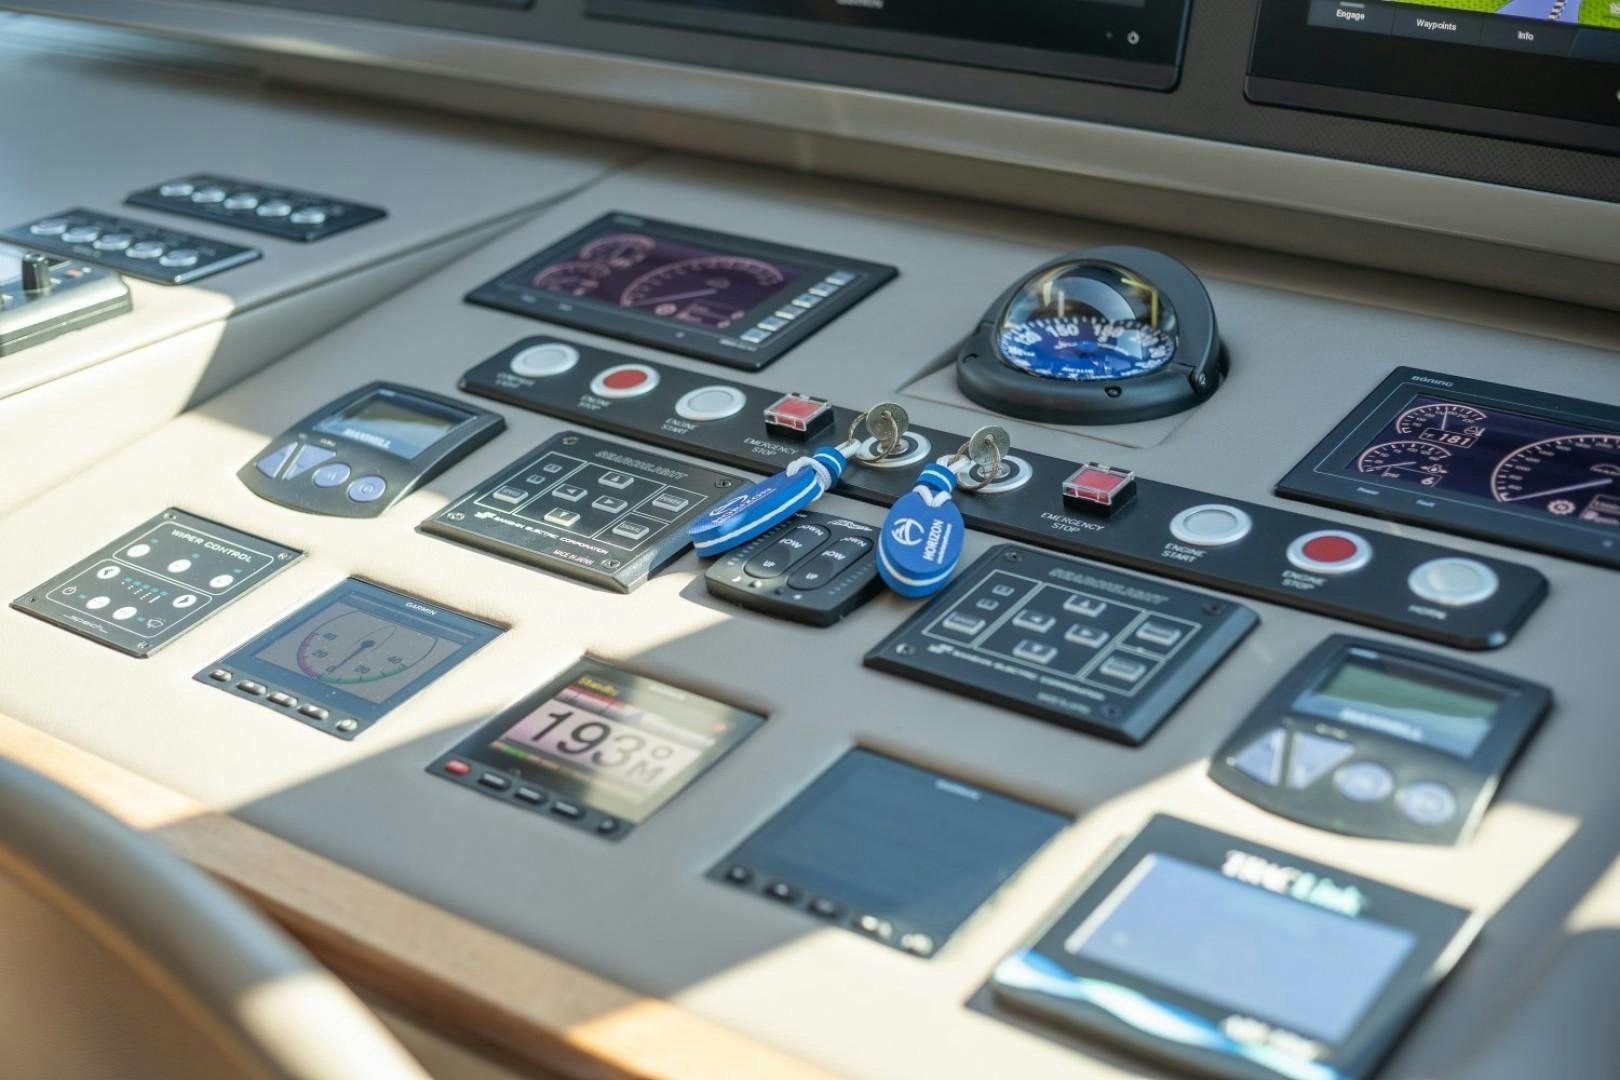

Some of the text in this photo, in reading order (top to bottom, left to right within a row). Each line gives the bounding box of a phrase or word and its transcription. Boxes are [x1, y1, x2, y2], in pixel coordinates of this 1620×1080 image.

[1336, 9, 1365, 21] Engage
[1416, 18, 1457, 32] Waypoints
[1517, 30, 1534, 41] Info
[661, 424, 689, 435] START
[665, 417, 698, 430] ENGINE
[743, 437, 800, 455] EMERGENCY
[1439, 433, 1471, 446] 181
[751, 446, 779, 457] STOP
[1040, 512, 1105, 533] EMERGENCY
[1050, 522, 1081, 535] STOP
[171, 528, 254, 563] WIPER CONTROL
[559, 535, 609, 555] CORPORATION
[922, 519, 945, 563] HORIZON
[1161, 550, 1199, 564] START
[1164, 542, 1208, 558] ENGINE
[1281, 578, 1316, 592] STOP
[1282, 570, 1325, 587] ENGINE
[405, 601, 438, 616] GARMIN
[312, 649, 330, 659] 20
[326, 664, 336, 673] 0
[353, 663, 371, 675] 20
[577, 676, 621, 698] Standby
[625, 763, 665, 783] M
